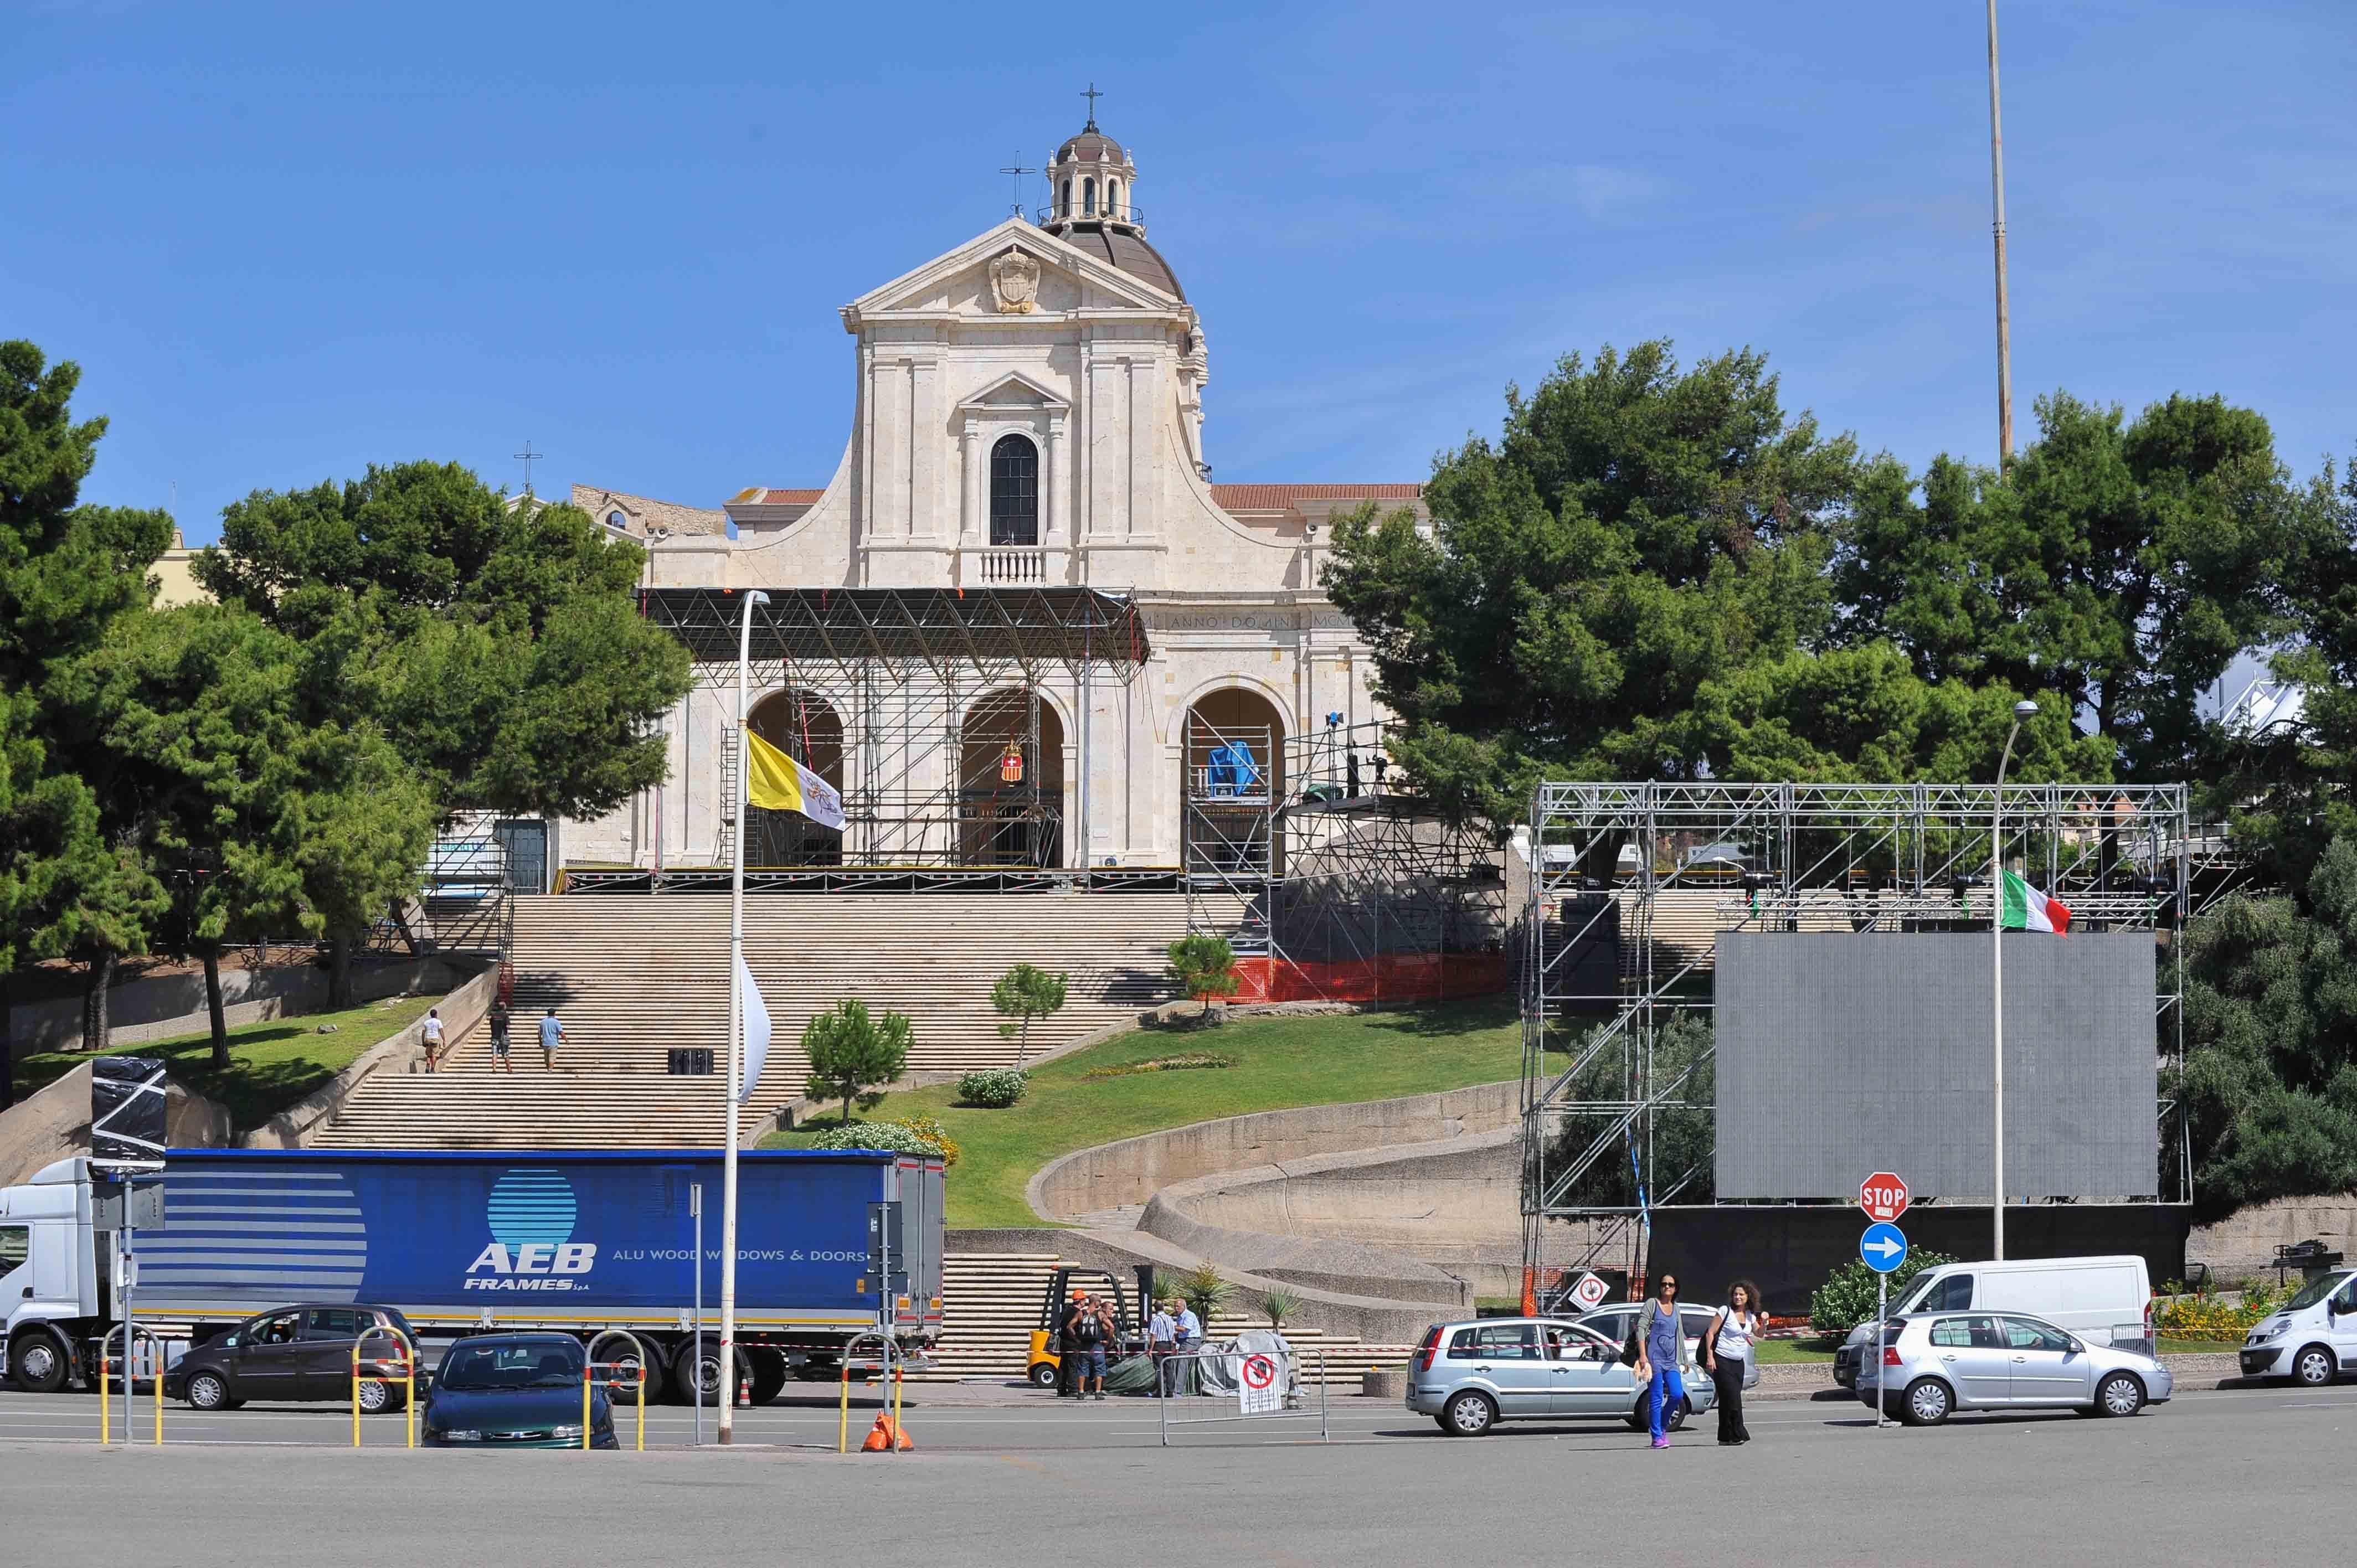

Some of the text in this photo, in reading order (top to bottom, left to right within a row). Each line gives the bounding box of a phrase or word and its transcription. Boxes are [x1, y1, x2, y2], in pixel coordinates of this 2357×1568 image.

[1171, 616, 1218, 628] ANNO
[1863, 1187, 1905, 1206] STOP
[465, 1243, 597, 1274] AEB
[613, 1250, 644, 1260] ALU
[706, 1250, 785, 1261] WDOWS
[790, 1249, 804, 1261] &
[810, 1250, 865, 1262] DOORS
[464, 1278, 574, 1290] FRAMES
